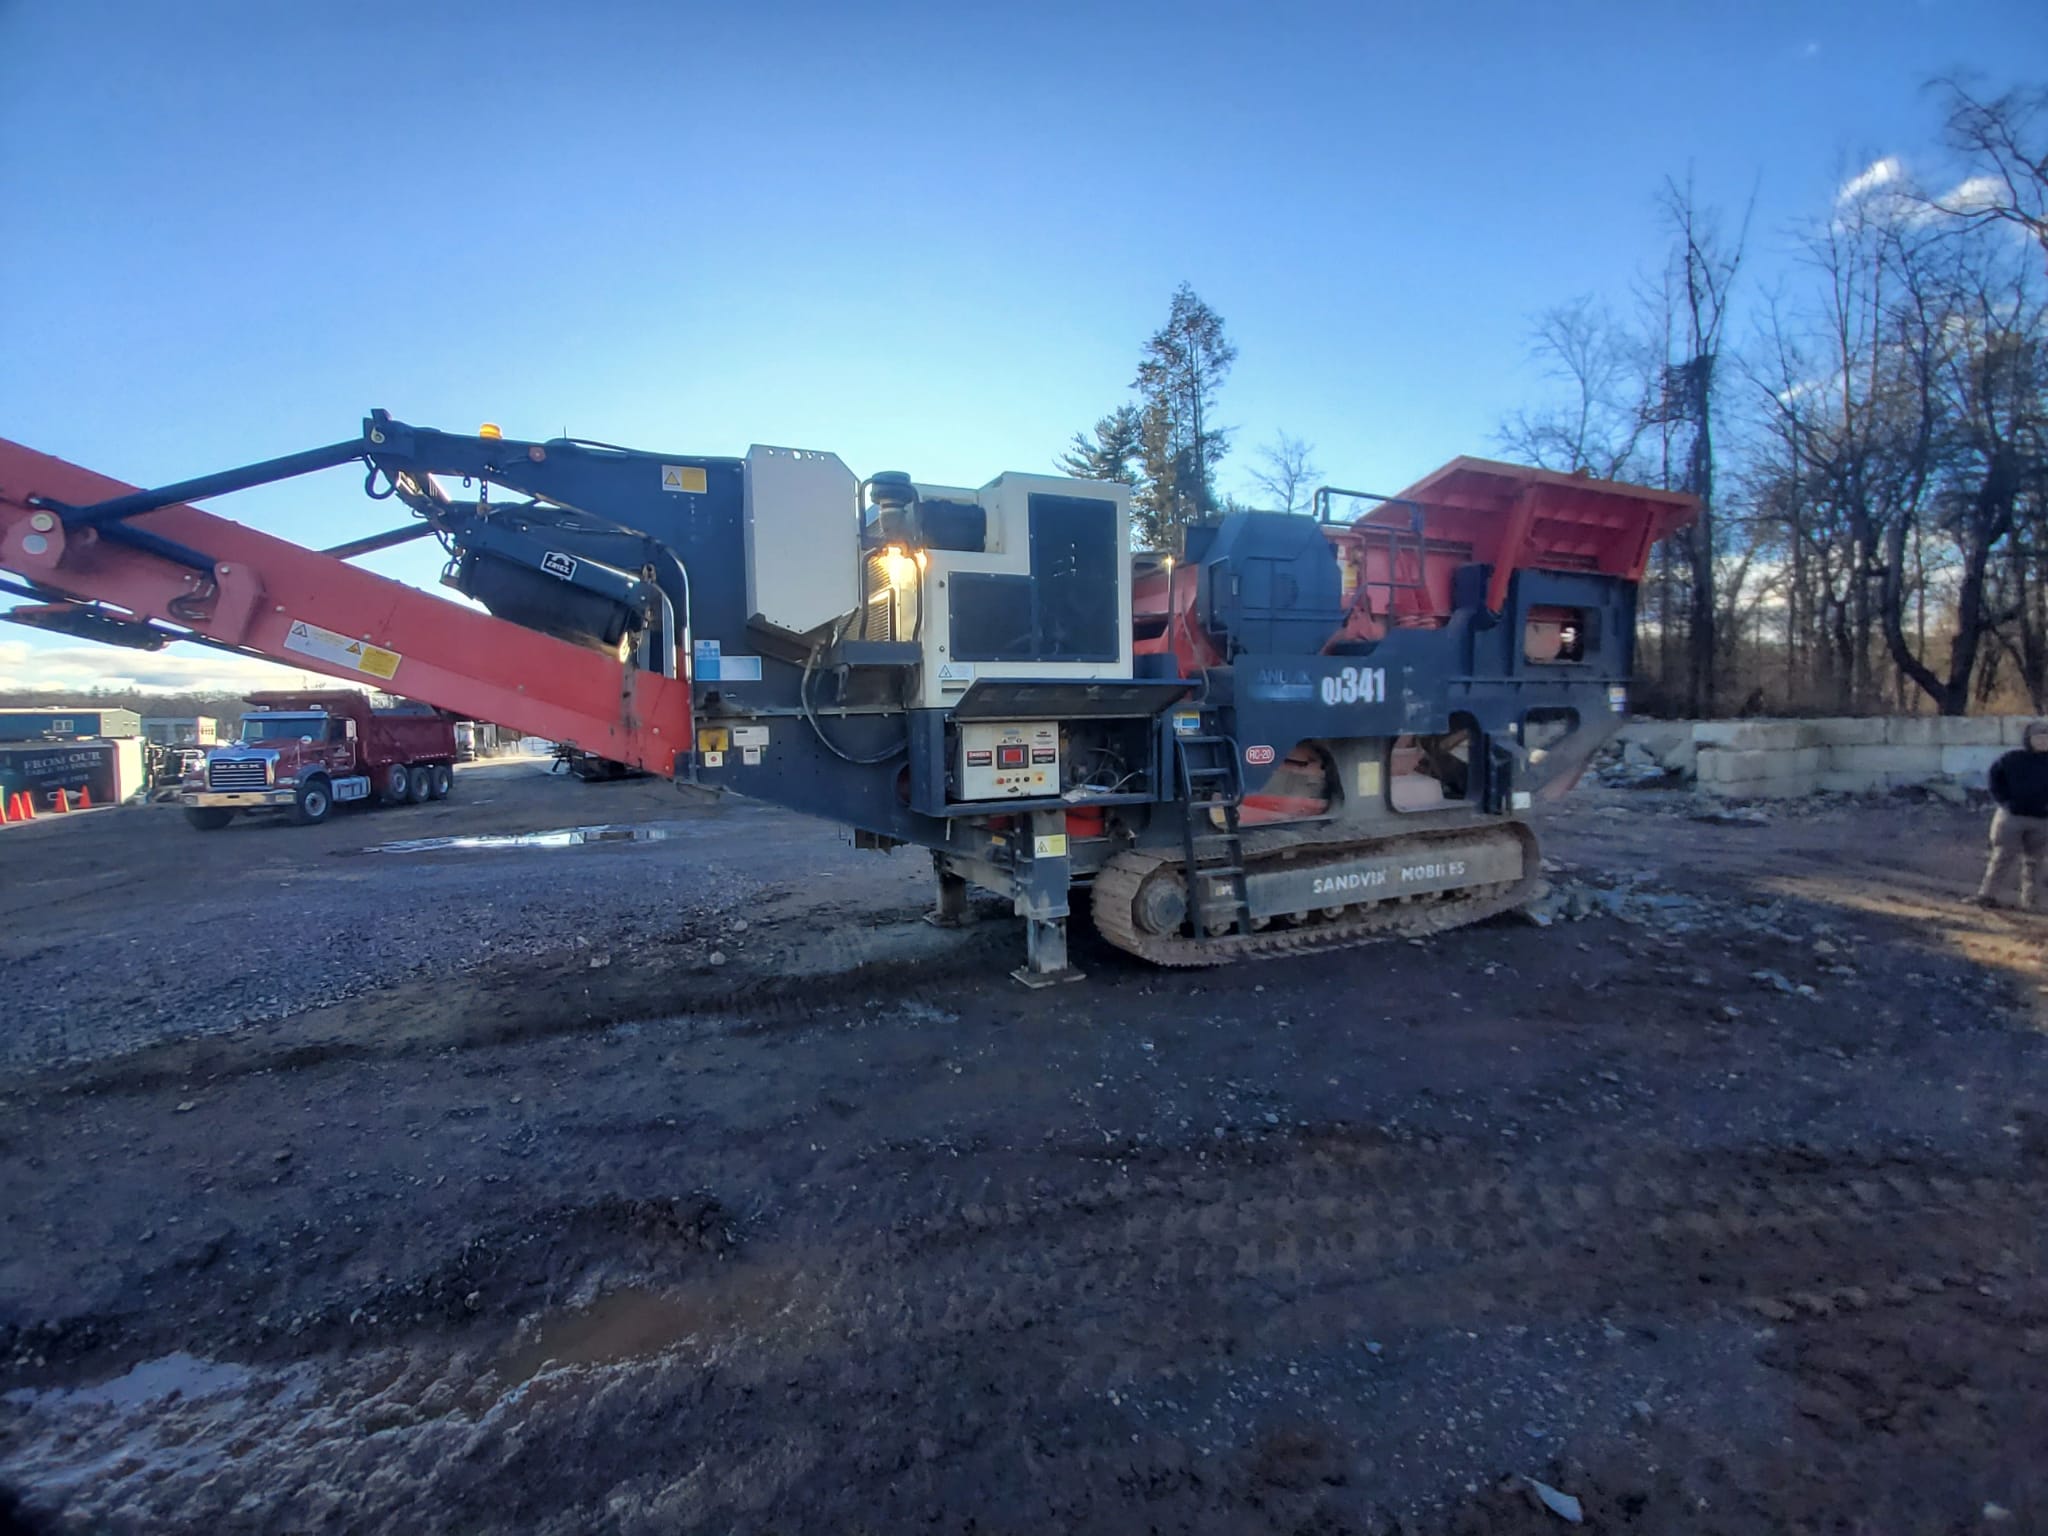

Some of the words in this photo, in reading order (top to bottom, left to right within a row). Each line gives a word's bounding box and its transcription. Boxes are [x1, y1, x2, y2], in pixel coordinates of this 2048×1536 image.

[1321, 666, 1386, 706] QJ341
[68, 751, 102, 763] OUR
[1312, 869, 1387, 894] SANDVIK
